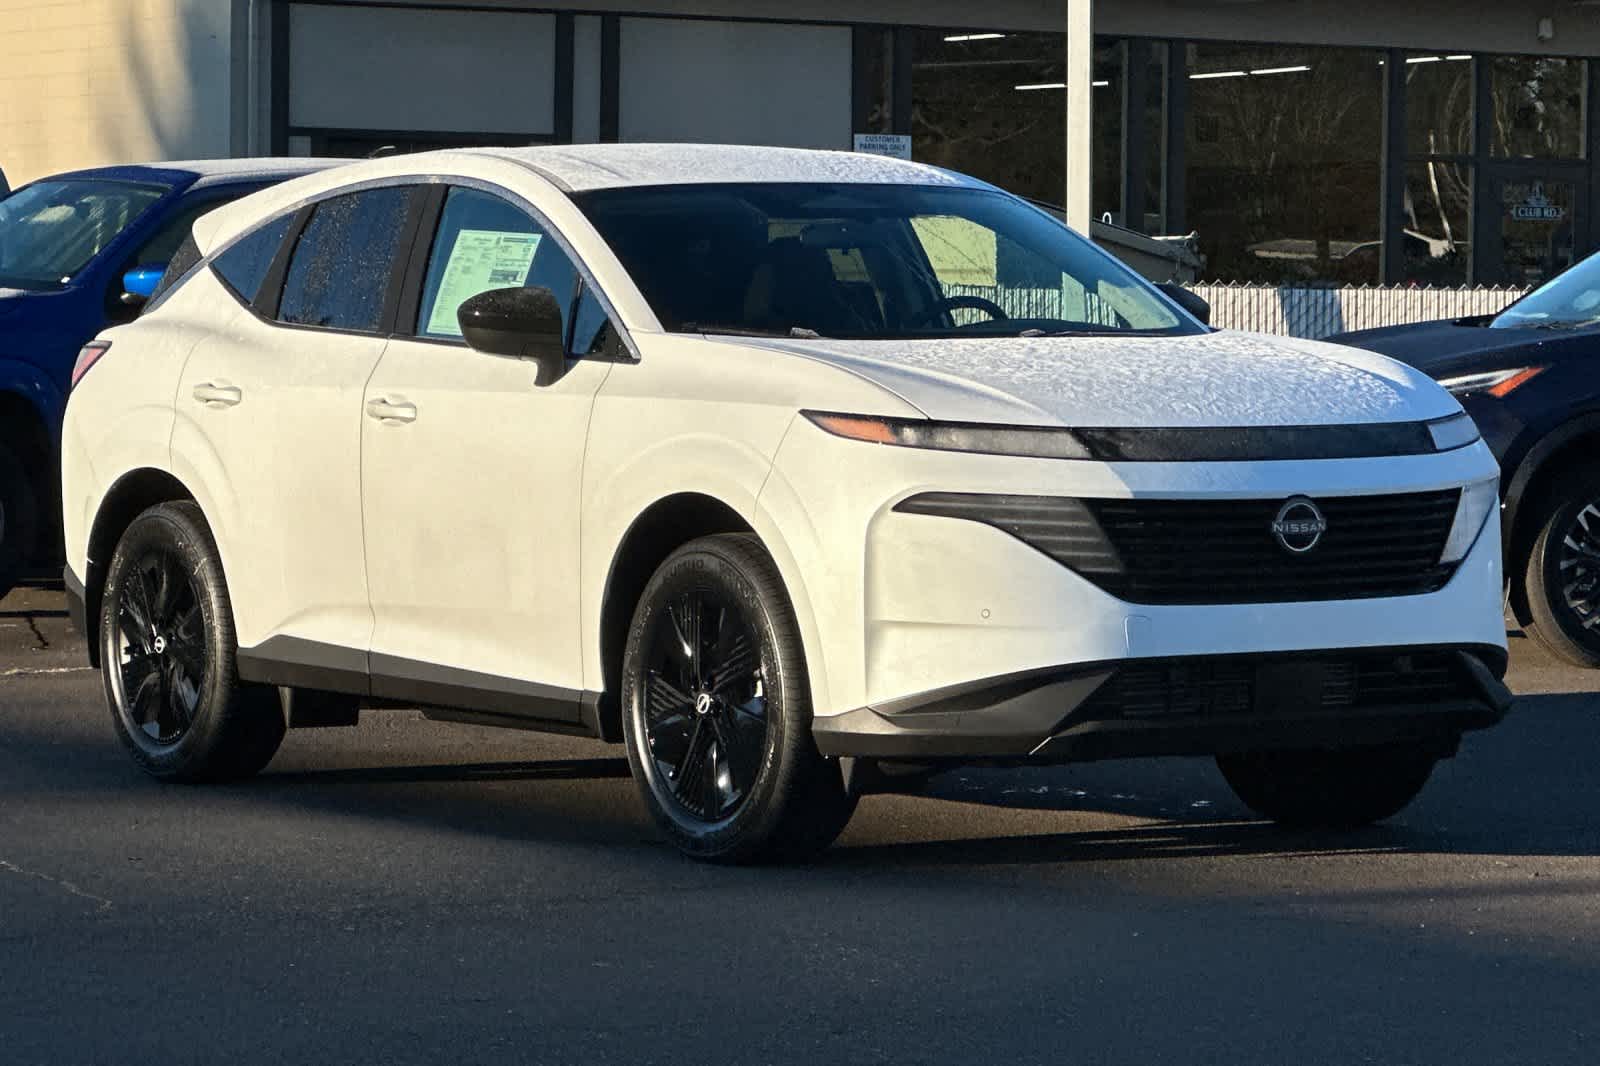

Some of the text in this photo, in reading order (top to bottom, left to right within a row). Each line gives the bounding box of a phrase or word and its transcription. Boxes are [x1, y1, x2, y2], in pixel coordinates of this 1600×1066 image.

[864, 135, 900, 143] CUSTOMER
[859, 143, 888, 151] PARKING
[1519, 208, 1541, 217] CLUB
[1272, 522, 1327, 533] NISSAN
